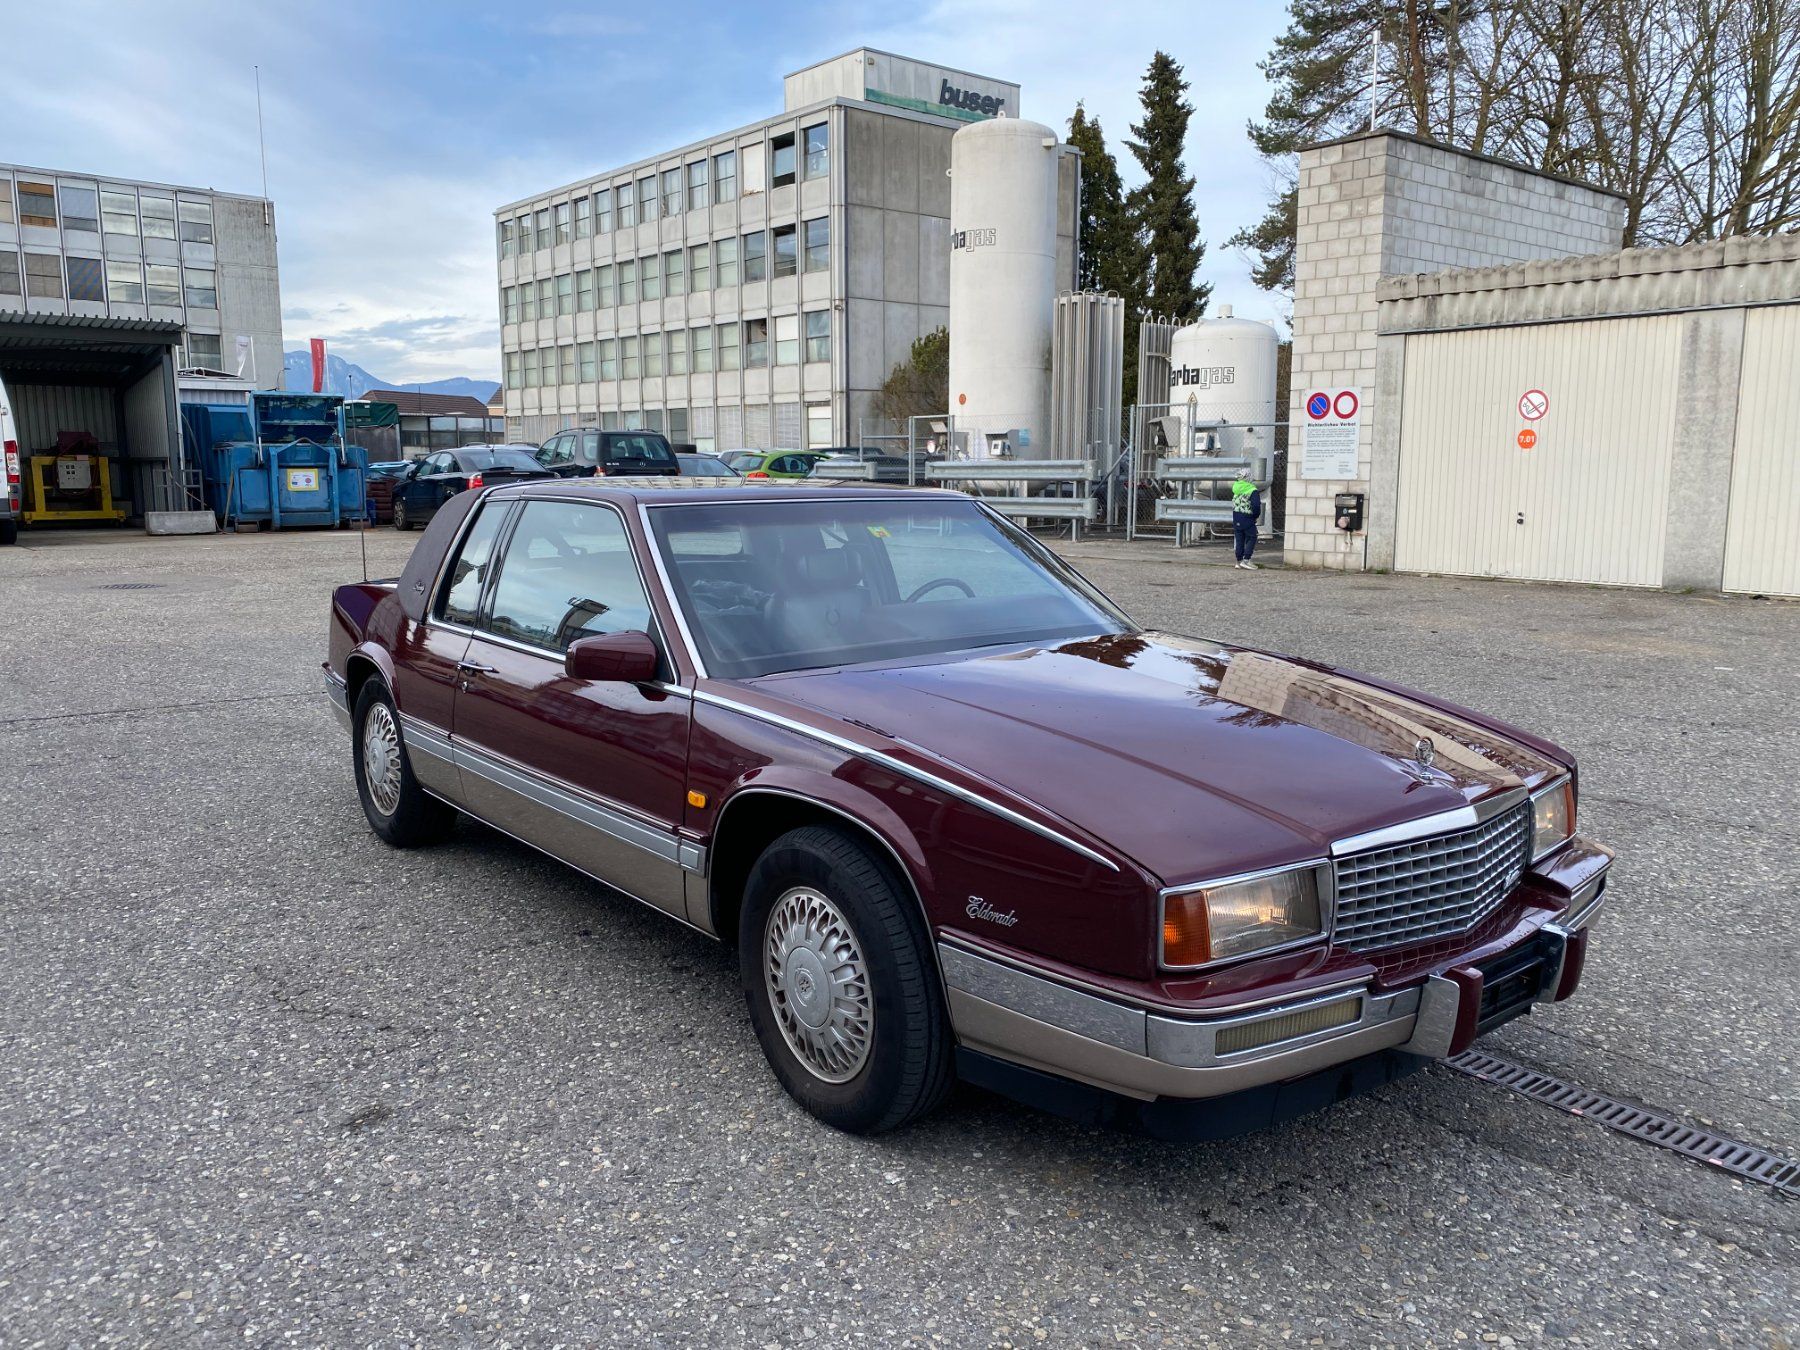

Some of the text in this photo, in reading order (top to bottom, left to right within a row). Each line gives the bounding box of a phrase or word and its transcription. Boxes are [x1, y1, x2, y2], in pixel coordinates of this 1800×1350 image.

[939, 78, 1005, 116] buser
[951, 228, 996, 252] bagas
[1170, 364, 1235, 389] arbagas
[966, 896, 1018, 927] Eldorado
